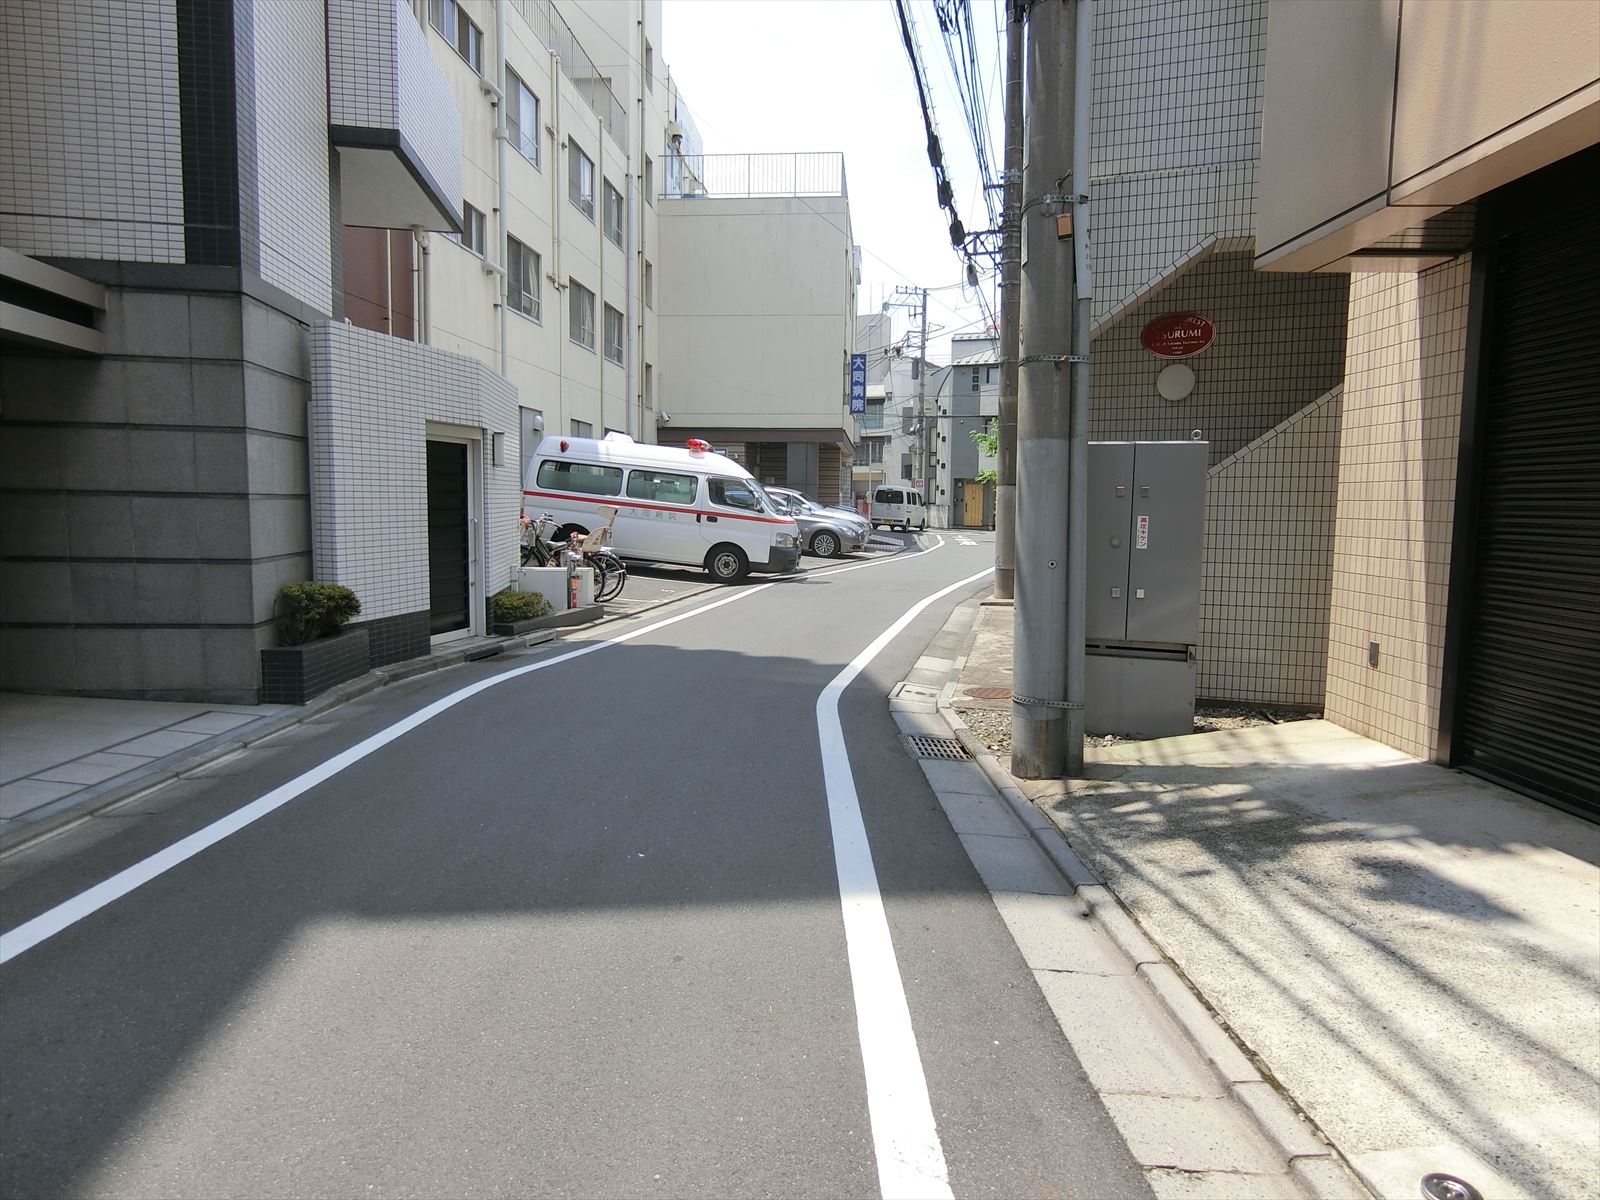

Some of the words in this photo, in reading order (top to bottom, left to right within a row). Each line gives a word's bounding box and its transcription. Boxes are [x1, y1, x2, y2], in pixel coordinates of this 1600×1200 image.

[1156, 329, 1201, 339] SURUMI
[853, 356, 865, 411] 大同病院
[1140, 517, 1148, 546] 高圧キケン
